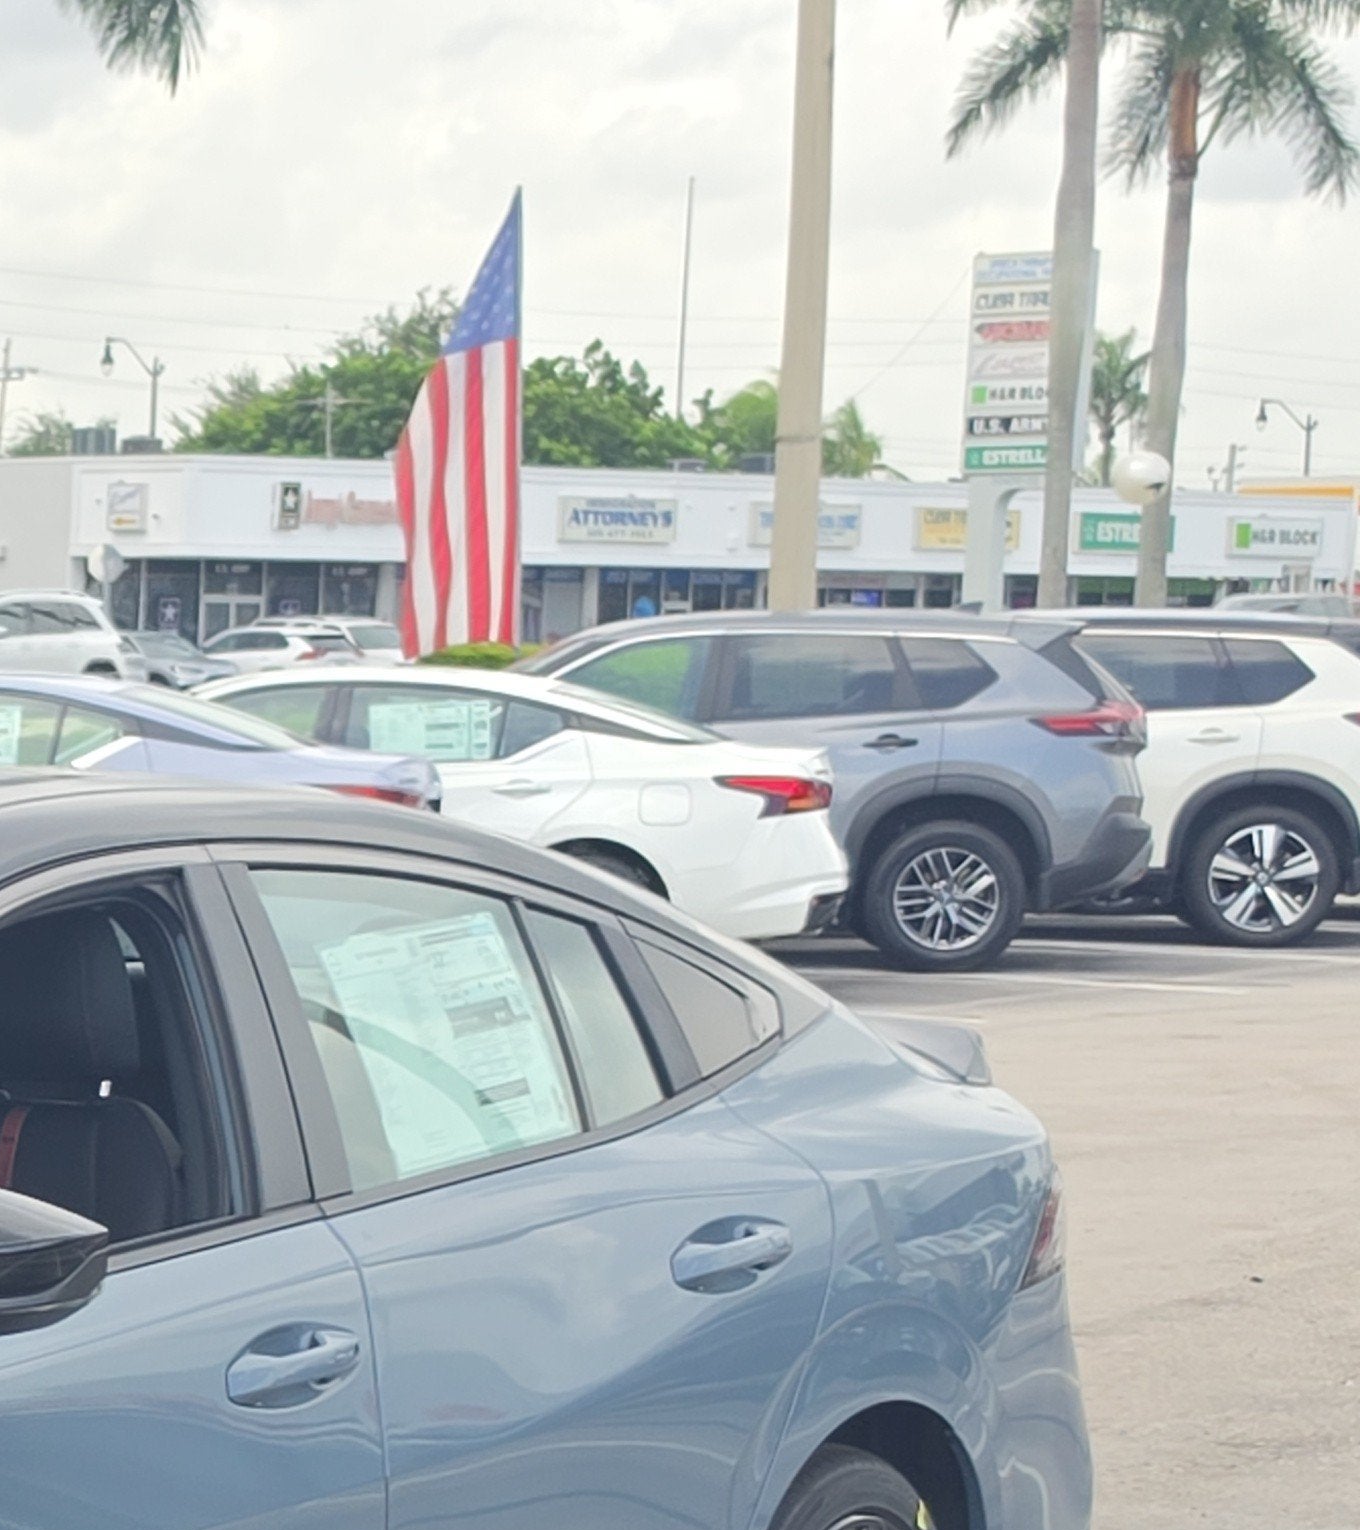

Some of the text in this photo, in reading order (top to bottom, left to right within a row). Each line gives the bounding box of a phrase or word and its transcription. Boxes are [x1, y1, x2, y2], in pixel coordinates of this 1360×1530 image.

[1019, 385, 1048, 401] BLO
[971, 417, 1002, 434] U.S.
[981, 447, 1047, 466] ESTRELL
[568, 507, 673, 528] ATTORNEYS
[1096, 520, 1141, 543] ESTRE
[1279, 528, 1318, 546] BLOCK
